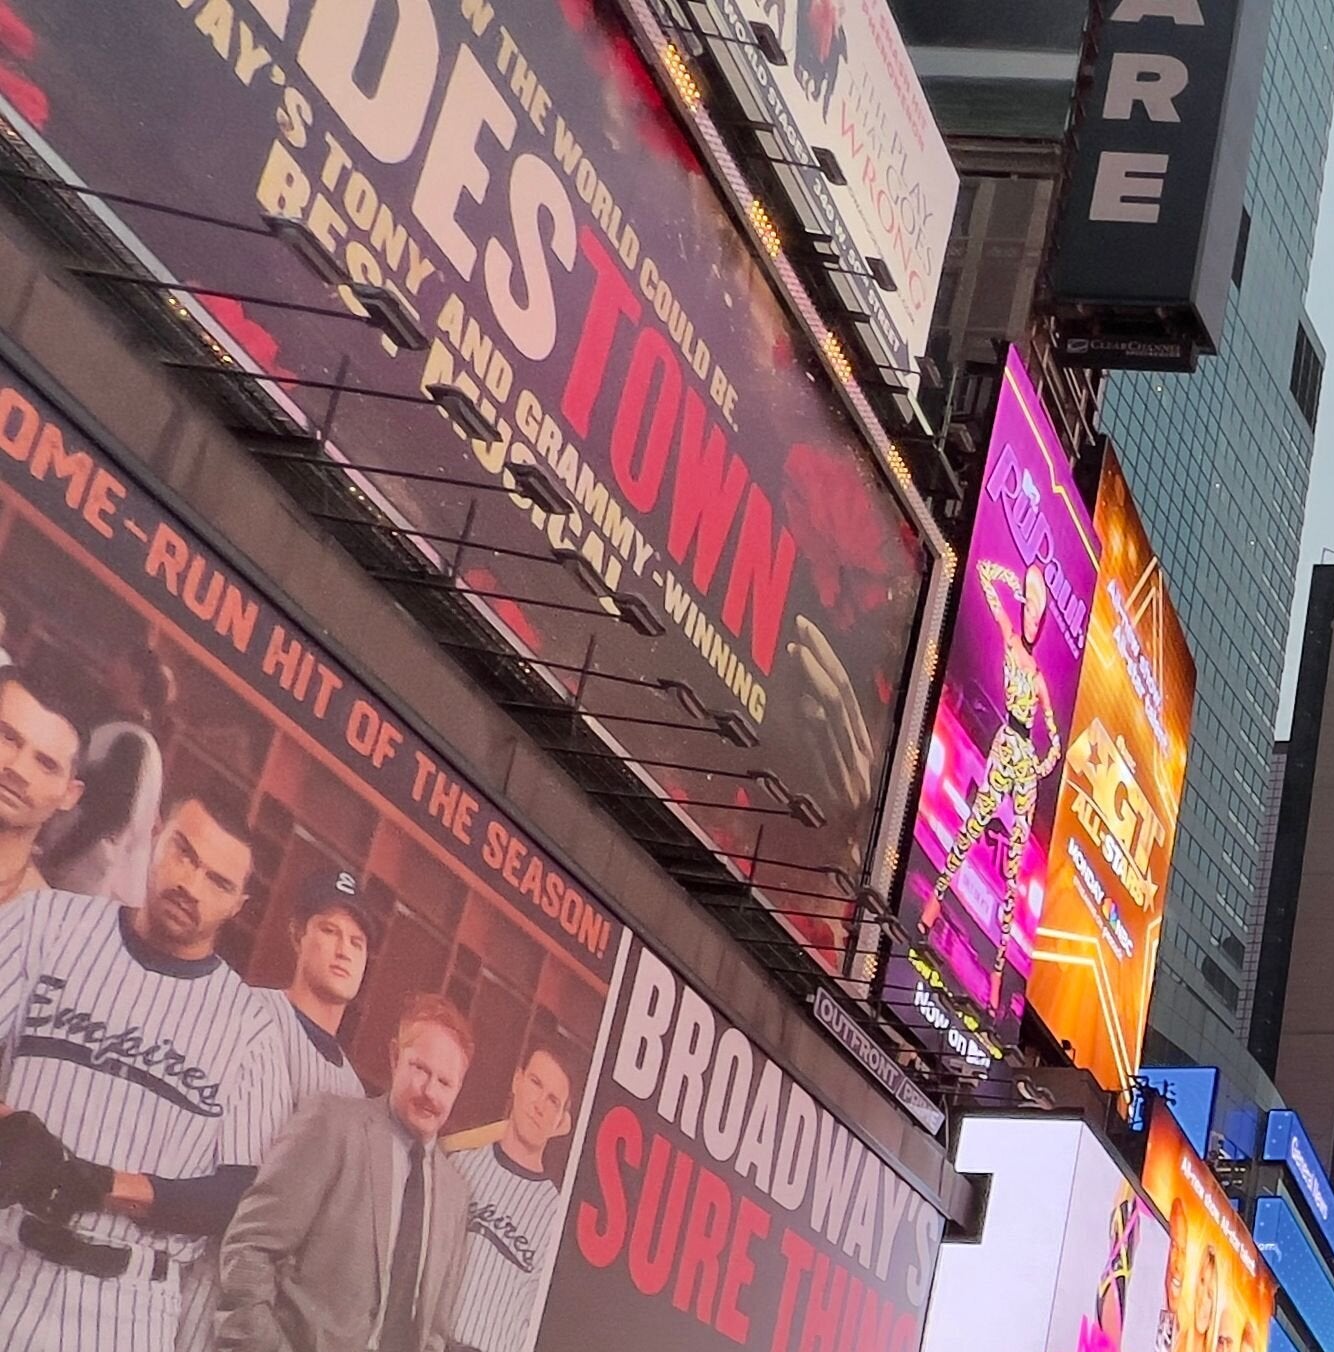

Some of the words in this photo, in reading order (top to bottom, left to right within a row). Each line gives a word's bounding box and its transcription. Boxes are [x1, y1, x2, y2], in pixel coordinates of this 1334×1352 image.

[497, 25, 552, 135] THE
[553, 115, 640, 270] WORLD
[640, 258, 707, 381] COULD
[709, 365, 739, 432] BE.
[725, 1, 767, 86] WORLD
[768, 86, 809, 171] STAGES
[841, 98, 925, 310] WRONG
[177, 0, 312, 148] AY'S
[321, 132, 437, 296] TONY
[436, 293, 513, 403] AND
[515, 389, 767, 723] GRAMMY-WINNING
[262, 625, 343, 718] HIT
[345, 701, 404, 769] OF
[411, 751, 479, 844] THE
[483, 819, 611, 960] SEASON!
[611, 946, 947, 1308] BROADWAY'S
[820, 999, 899, 1087] OUTFRONT
[576, 1104, 774, 1345] SURE
